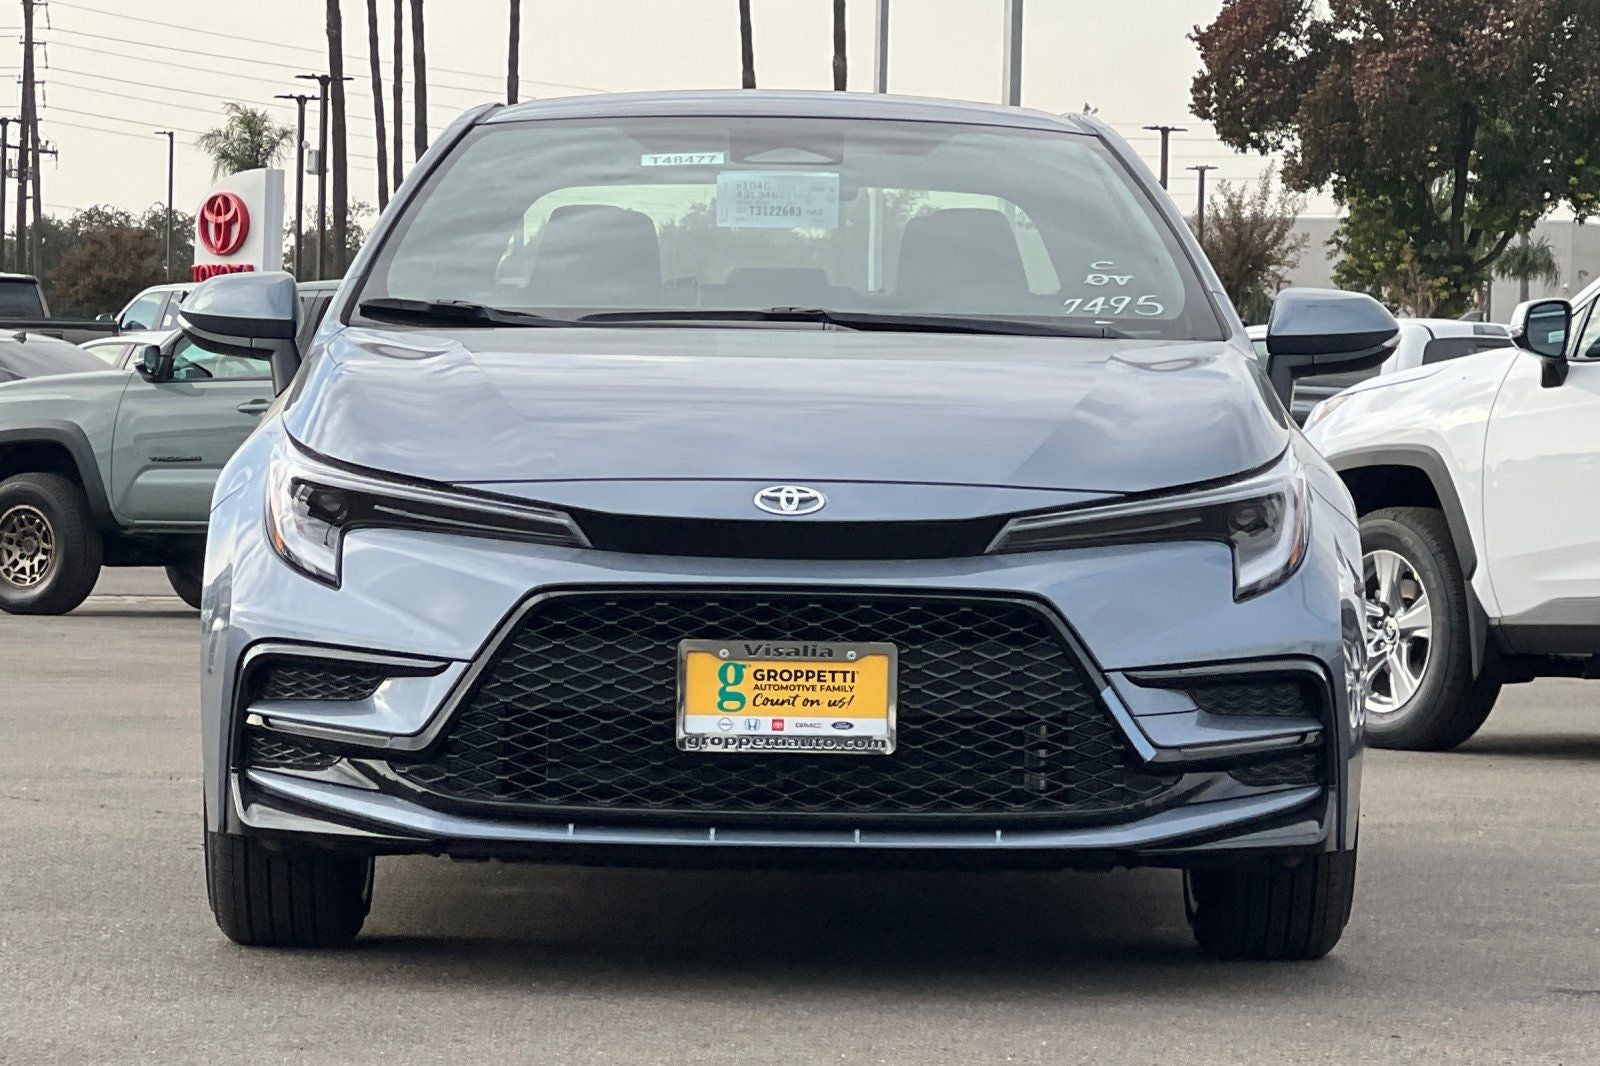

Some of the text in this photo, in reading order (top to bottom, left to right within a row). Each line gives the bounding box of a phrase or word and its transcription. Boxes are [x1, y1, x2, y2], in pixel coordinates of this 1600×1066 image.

[1063, 294, 1164, 316] 7495
[744, 644, 834, 657] Visalia
[753, 669, 856, 683] GROPPETTI
[753, 683, 855, 693] AUTOMOTIVE FAMILY
[752, 693, 855, 709] Count on us!
